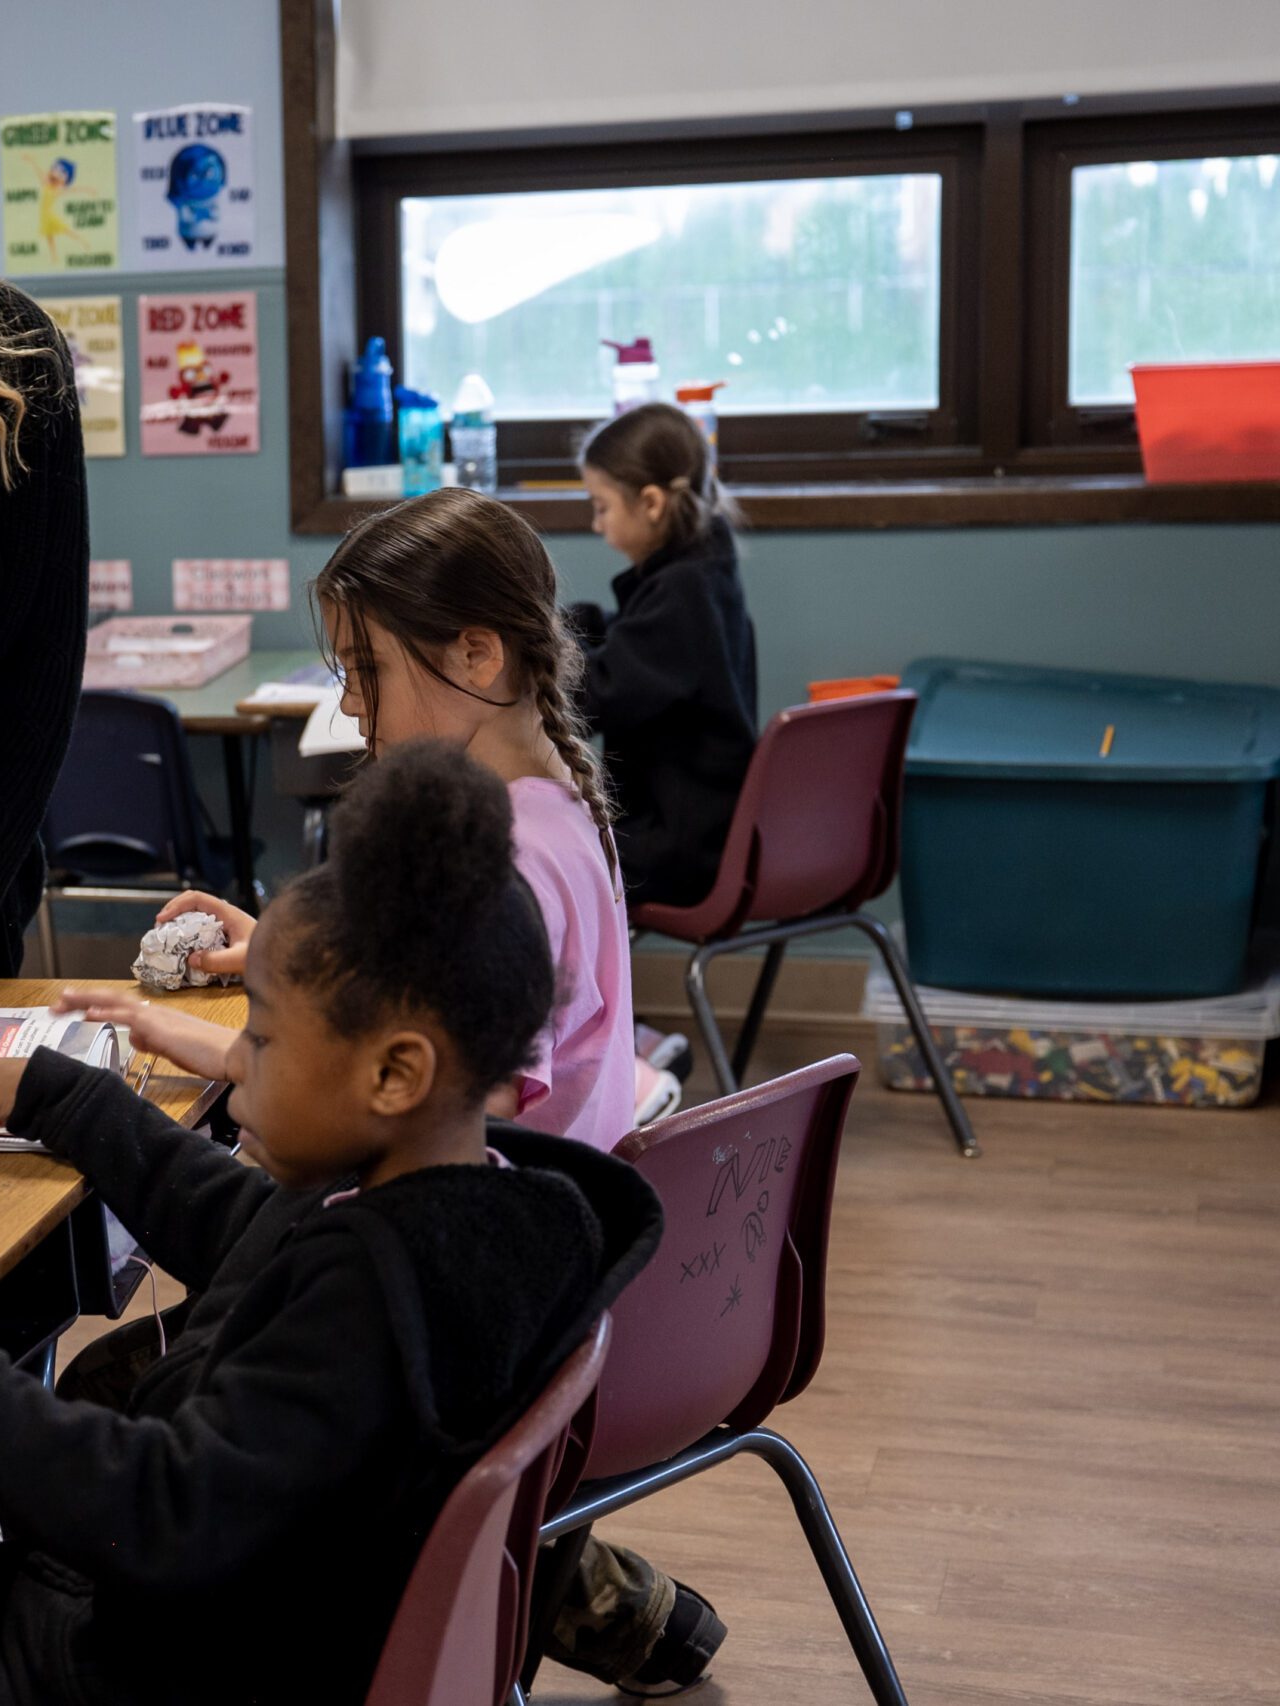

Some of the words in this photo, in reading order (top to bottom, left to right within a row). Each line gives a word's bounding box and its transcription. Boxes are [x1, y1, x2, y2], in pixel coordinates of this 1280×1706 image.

[2, 121, 58, 148] GREEN
[144, 115, 190, 140] BLUE
[196, 112, 243, 137] ZONE
[147, 305, 186, 332] RED
[190, 302, 247, 332] ZONE
